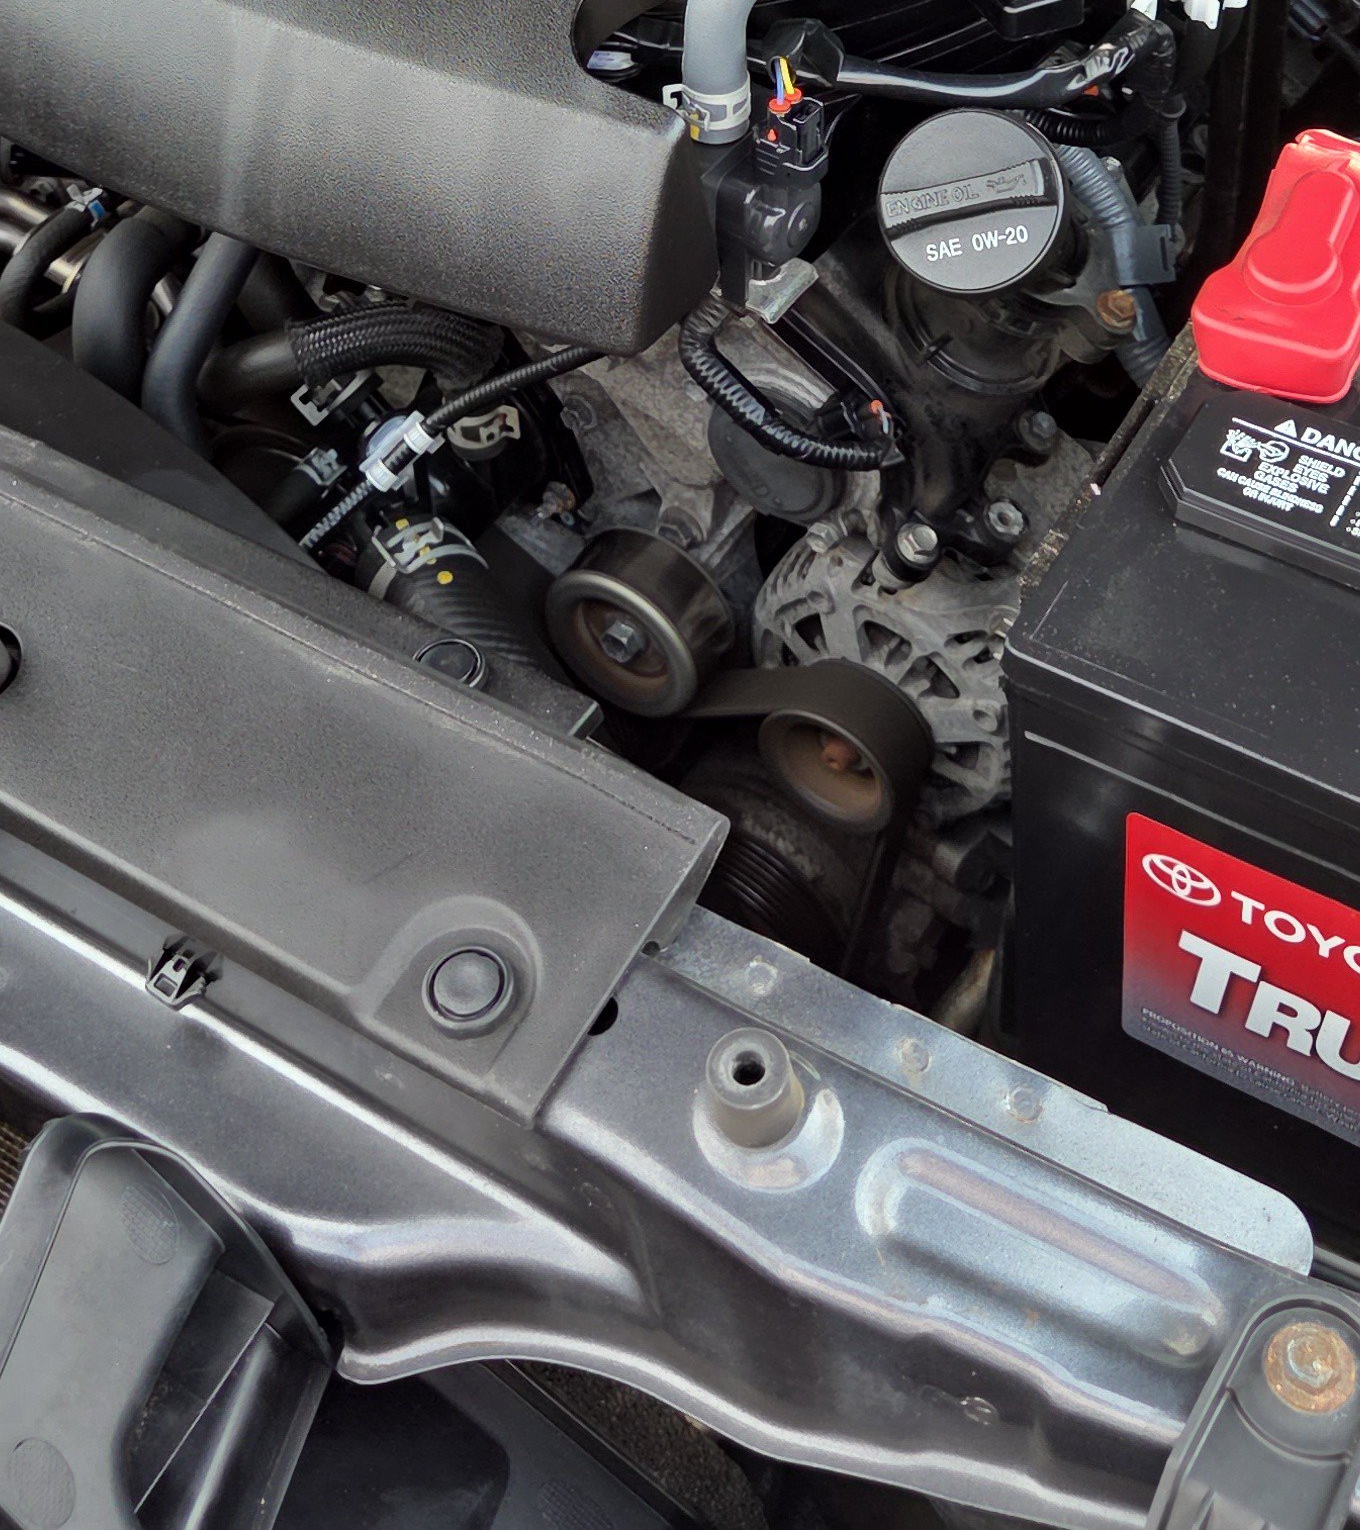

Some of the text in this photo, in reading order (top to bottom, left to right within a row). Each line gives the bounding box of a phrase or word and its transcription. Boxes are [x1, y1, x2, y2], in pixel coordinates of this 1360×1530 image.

[886, 183, 980, 218] ENGINE OIL
[926, 225, 1029, 262] SAE 0W-20
[1253, 470, 1299, 494] GASES
[1258, 461, 1332, 495] EXPLOSIVE
[1293, 464, 1329, 482] EYES
[1298, 455, 1346, 478] SHIELD
[1217, 467, 1324, 514] CAN CAUSE BLINDNESS
[1242, 486, 1295, 513] OR INJURY
[1142, 1007, 1222, 1051] PROPOSITION
